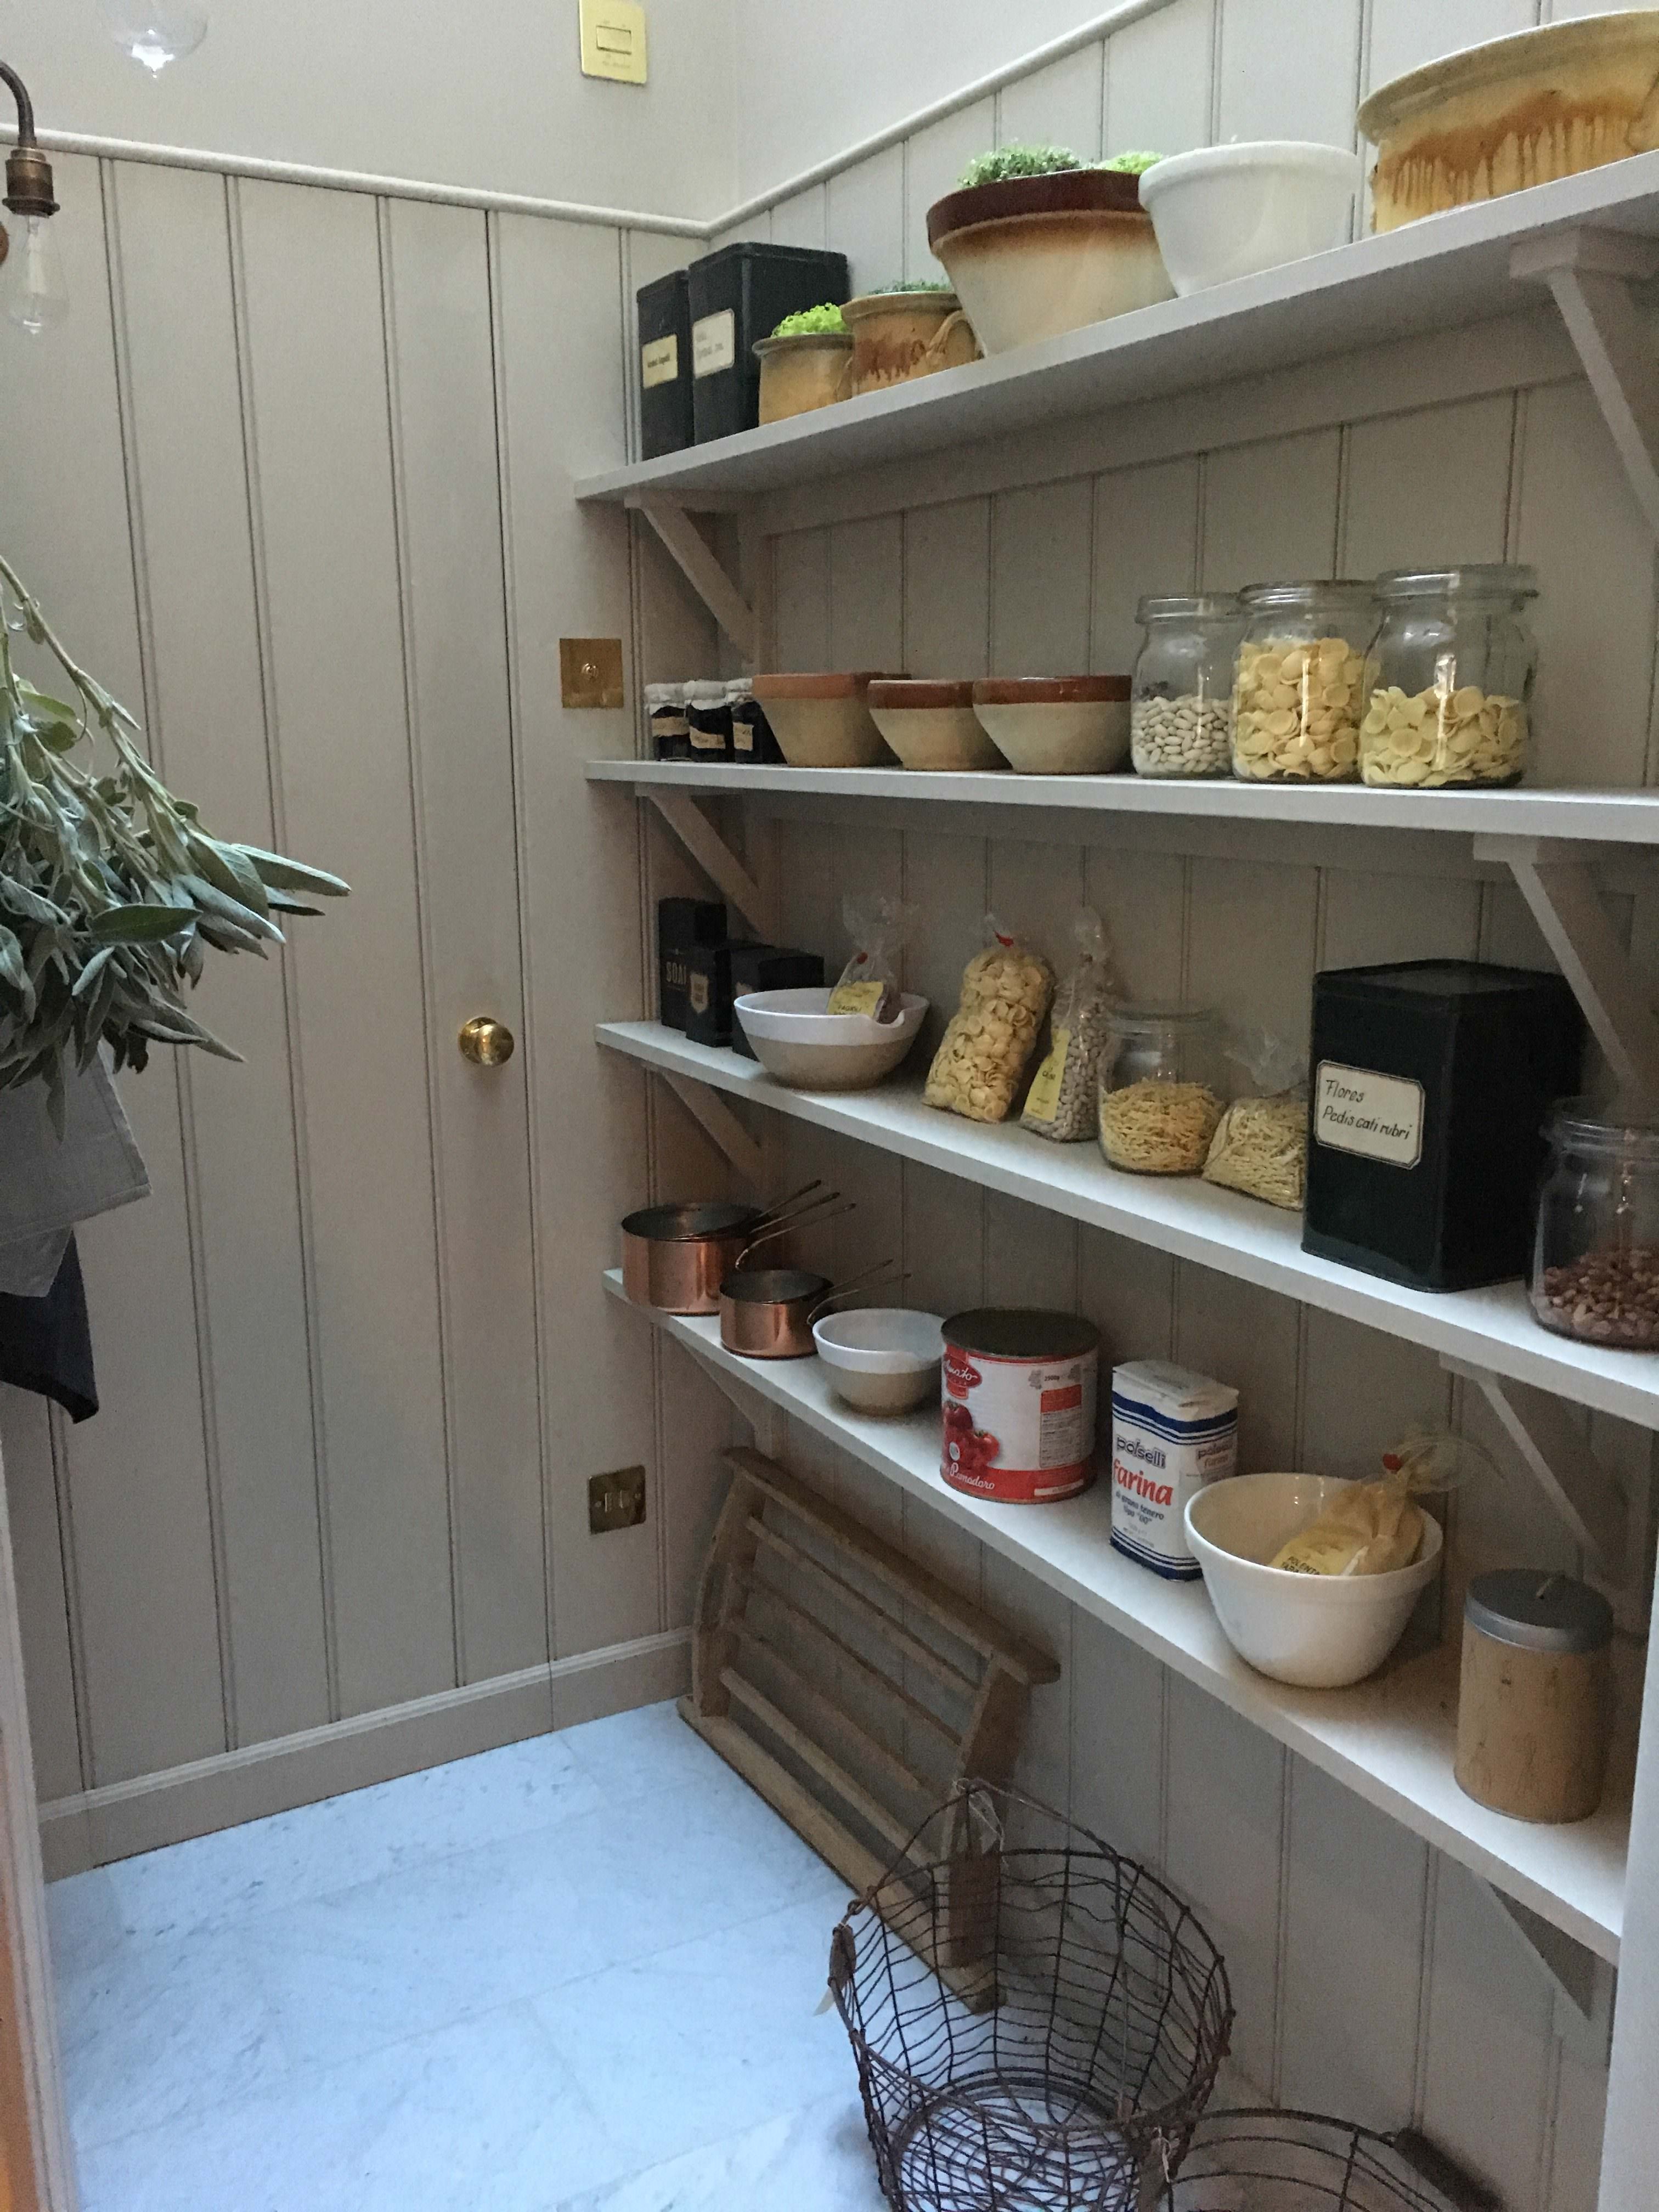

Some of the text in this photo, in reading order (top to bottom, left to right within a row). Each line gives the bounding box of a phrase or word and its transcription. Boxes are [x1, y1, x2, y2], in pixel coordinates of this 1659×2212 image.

[1325, 1080, 1365, 1103] Flores
[1379, 1124, 1413, 1140] rubri
[950, 1462, 996, 1490] Pomodoro
[1113, 1458, 1173, 1506] farina
